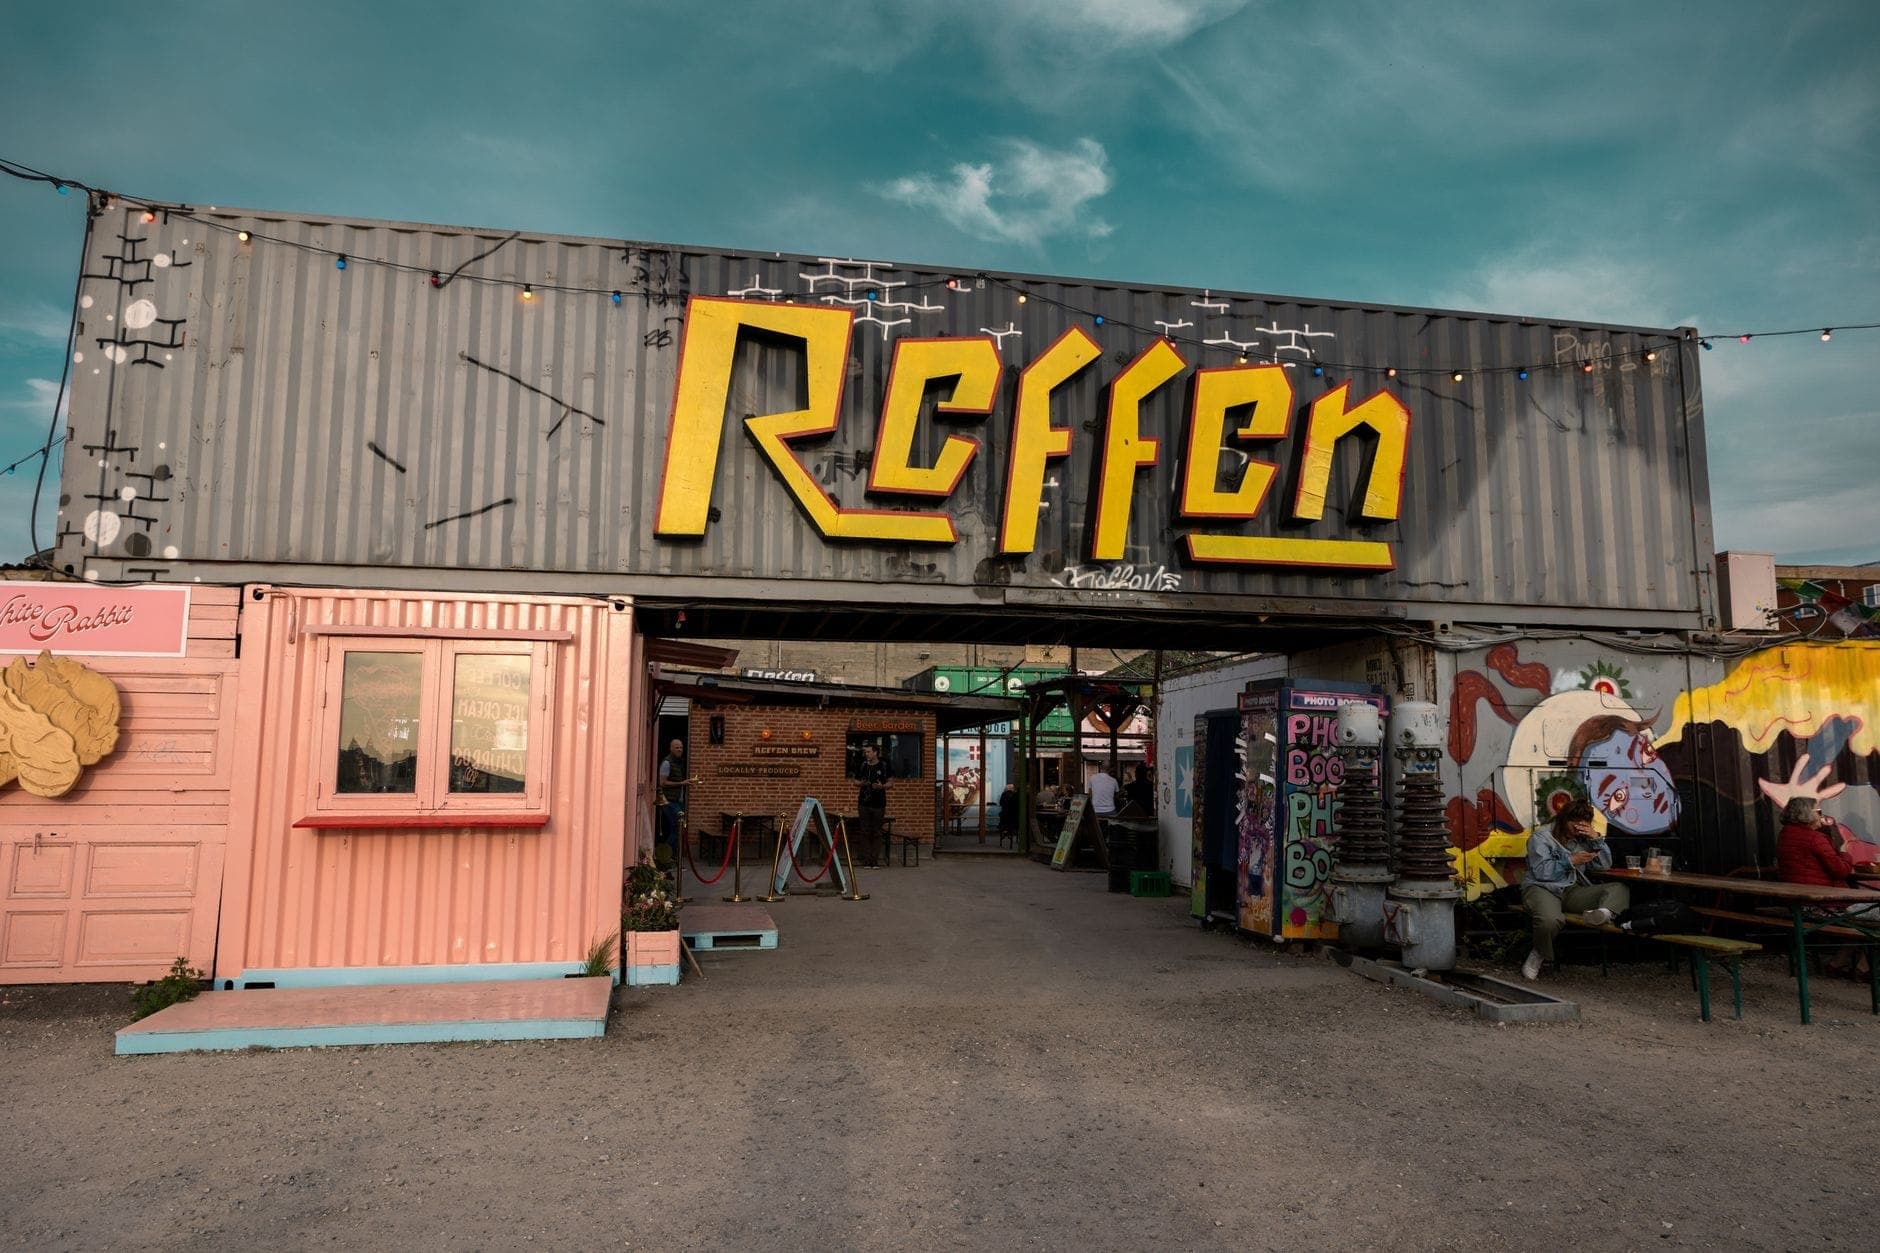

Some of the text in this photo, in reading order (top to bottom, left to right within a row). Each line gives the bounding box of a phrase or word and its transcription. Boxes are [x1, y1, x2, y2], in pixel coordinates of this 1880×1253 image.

[654, 295, 1411, 572] Reffen
[29, 605, 133, 642] Rabbit
[1304, 697, 1336, 706] PHOTO
[857, 720, 879, 729] Beer
[791, 747, 818, 755] BREW
[719, 766, 800, 775] LOCALLY PRODUCED
